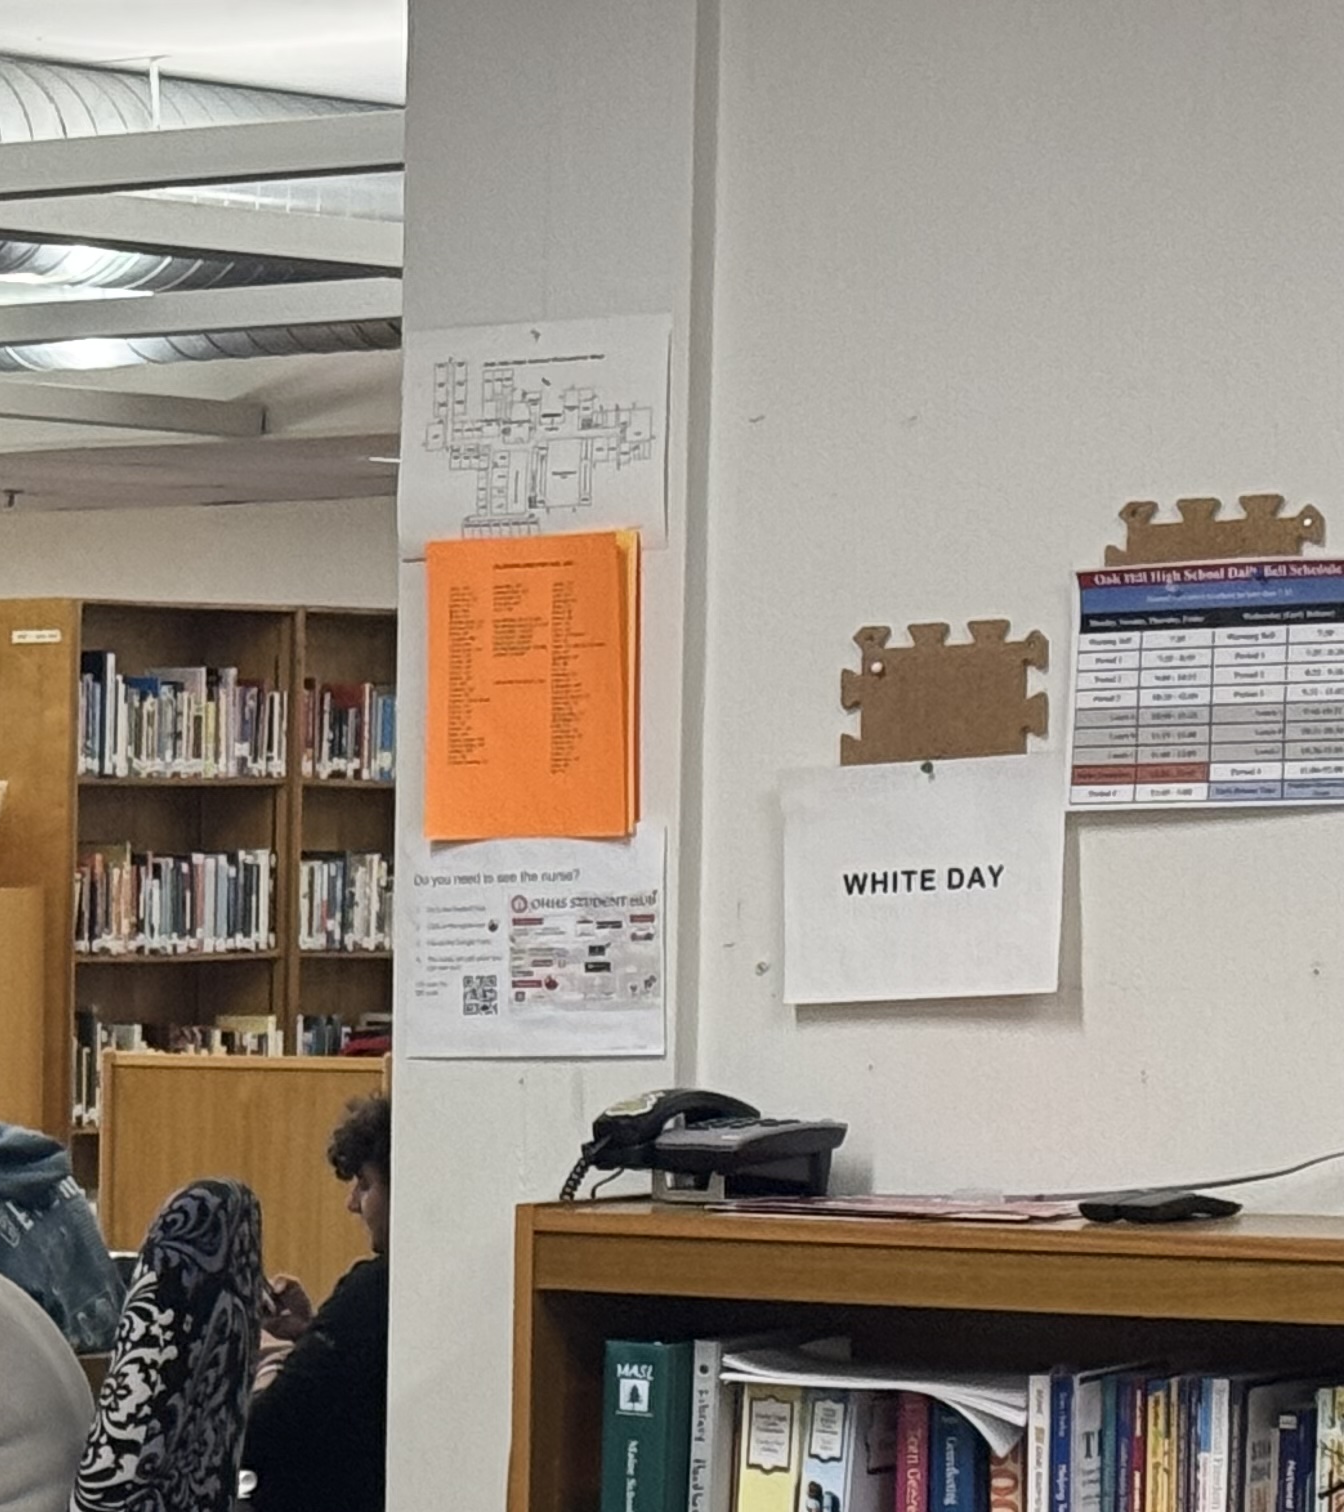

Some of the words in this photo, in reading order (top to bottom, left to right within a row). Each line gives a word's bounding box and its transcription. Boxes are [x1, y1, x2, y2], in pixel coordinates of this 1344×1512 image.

[1094, 573, 1121, 585] Oak
[1151, 570, 1181, 584] High
[1184, 568, 1225, 581] School
[413, 872, 429, 887] Do
[431, 875, 451, 889] you
[454, 872, 481, 886] need
[483, 873, 494, 885] to
[496, 873, 517, 884] see
[520, 870, 539, 883] the
[541, 868, 580, 883] nurse?
[843, 869, 937, 896] WHITE
[947, 864, 1004, 891] DAY
[617, 1363, 655, 1381] MASL
[625, 1440, 639, 1476] Maine
